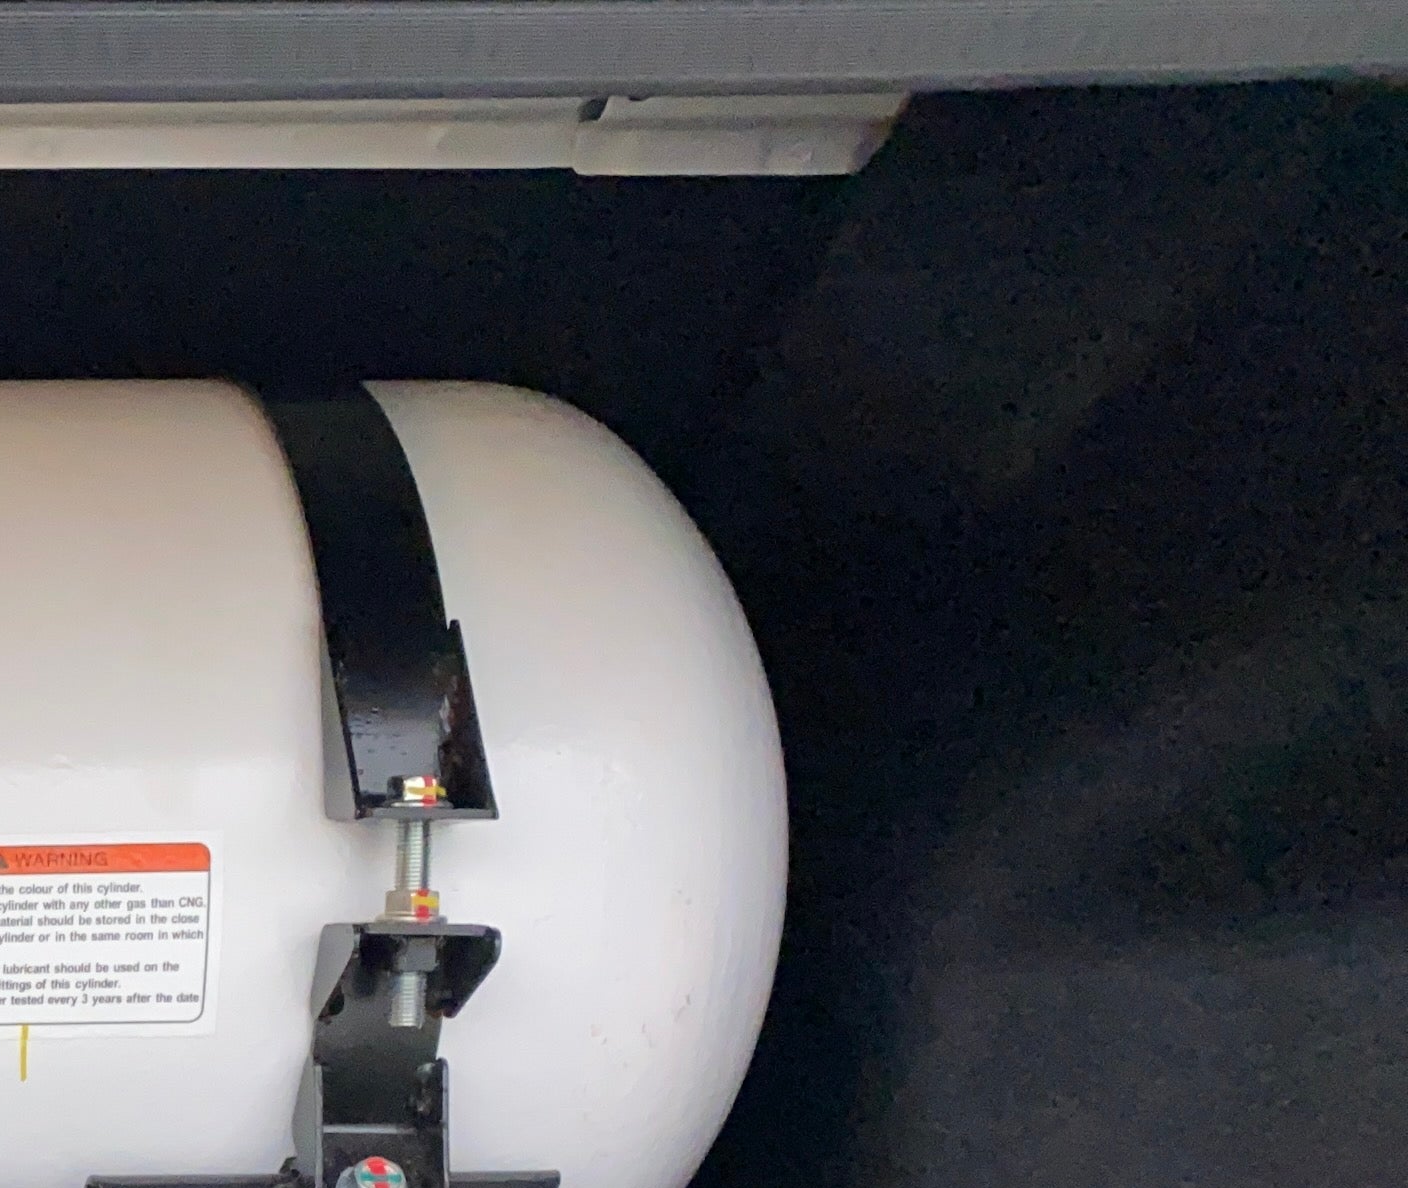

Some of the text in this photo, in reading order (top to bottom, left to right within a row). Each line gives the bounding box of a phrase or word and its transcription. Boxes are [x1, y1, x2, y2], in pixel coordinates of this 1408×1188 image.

[15, 851, 108, 868] WARNING
[19, 884, 53, 894] colour
[58, 883, 69, 893] of
[73, 883, 92, 893] this
[97, 883, 143, 895] cylinder.
[43, 900, 65, 910] with
[70, 901, 89, 912] any
[94, 899, 121, 909] other
[127, 900, 146, 911] gas
[151, 899, 174, 908] than
[179, 897, 206, 907] CNG.
[38, 915, 73, 926] should
[79, 915, 92, 925] be
[95, 915, 130, 924] stored
[136, 915, 145, 924] in
[151, 914, 167, 924] the
[171, 914, 199, 923] close
[39, 933, 50, 942] or
[55, 932, 65, 941] in
[70, 931, 86, 941] the
[91, 932, 120, 941] same
[125, 931, 153, 940] room
[158, 930, 168, 939] in
[172, 930, 203, 939] which
[3, 964, 50, 974] lubricant
[54, 963, 91, 973] should
[96, 963, 109, 972] be
[113, 962, 139, 972] used
[163, 961, 179, 971] the
[36, 980, 47, 989] of
[51, 979, 70, 989] this
[75, 978, 121, 991] cylinder.
[11, 995, 44, 1005] tested
[48, 995, 77, 1006] every
[82, 994, 88, 1004] 3
[93, 995, 122, 1006] years
[126, 993, 151, 1003] after
[156, 993, 172, 1003] the
[177, 993, 199, 1002] date
